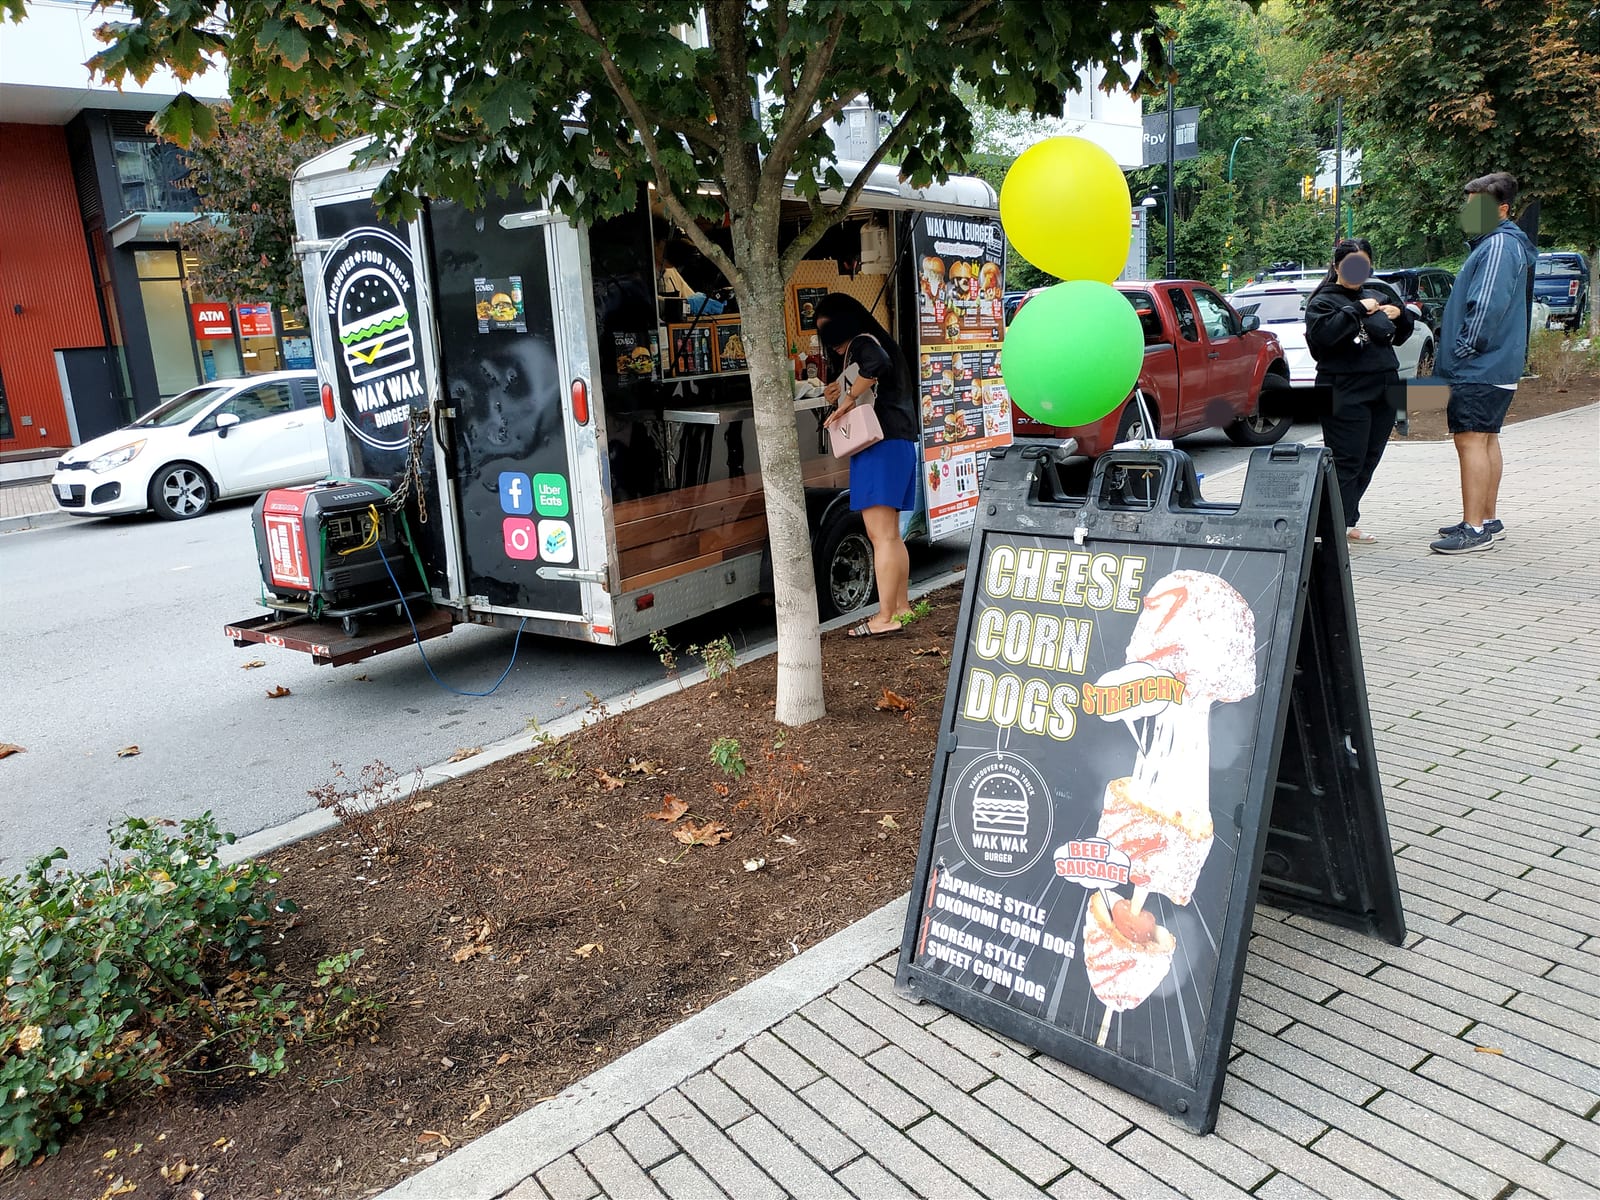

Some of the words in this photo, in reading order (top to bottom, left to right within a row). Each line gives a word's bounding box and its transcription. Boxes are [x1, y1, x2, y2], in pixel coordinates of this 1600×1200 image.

[1143, 133, 1166, 145] RDV
[925, 216, 945, 238] WAK
[945, 219, 964, 240] WAK
[964, 222, 994, 247] BURGER
[328, 255, 356, 315] VANCOUVER
[361, 250, 383, 265] FOOD
[385, 257, 411, 293] TRUCK
[198, 310, 225, 322] ATM
[352, 380, 389, 413] WAK
[386, 369, 424, 403] WAK
[333, 491, 373, 501] HONDA
[538, 484, 561, 495] Uber
[540, 495, 562, 506] Eats
[985, 545, 1147, 613] CHEESE
[976, 607, 1093, 675] CORN
[964, 668, 1080, 741] DOGS
[1082, 676, 1185, 715] STRETCHY
[968, 763, 999, 790] VANCOUVER
[1004, 763, 1020, 776] FOOD
[1020, 774, 1036, 796] TRUCK
[972, 833, 998, 850] WAK
[1000, 836, 1028, 853] WAK
[984, 851, 1013, 864] BURGER
[1069, 842, 1109, 860] BEEF
[1055, 860, 1129, 884] SAUSAGE
[938, 871, 1003, 909] JAPANESE
[1003, 896, 1047, 925] SYTLE
[935, 893, 999, 930] OKONOMI
[1000, 917, 1041, 946] CORN
[1042, 932, 1076, 959] DOG
[930, 920, 983, 954] KOREAN
[984, 941, 1026, 972] STYLE
[927, 940, 972, 970] SWEET
[972, 959, 1012, 988] CORN
[1014, 975, 1046, 1002] DOG
